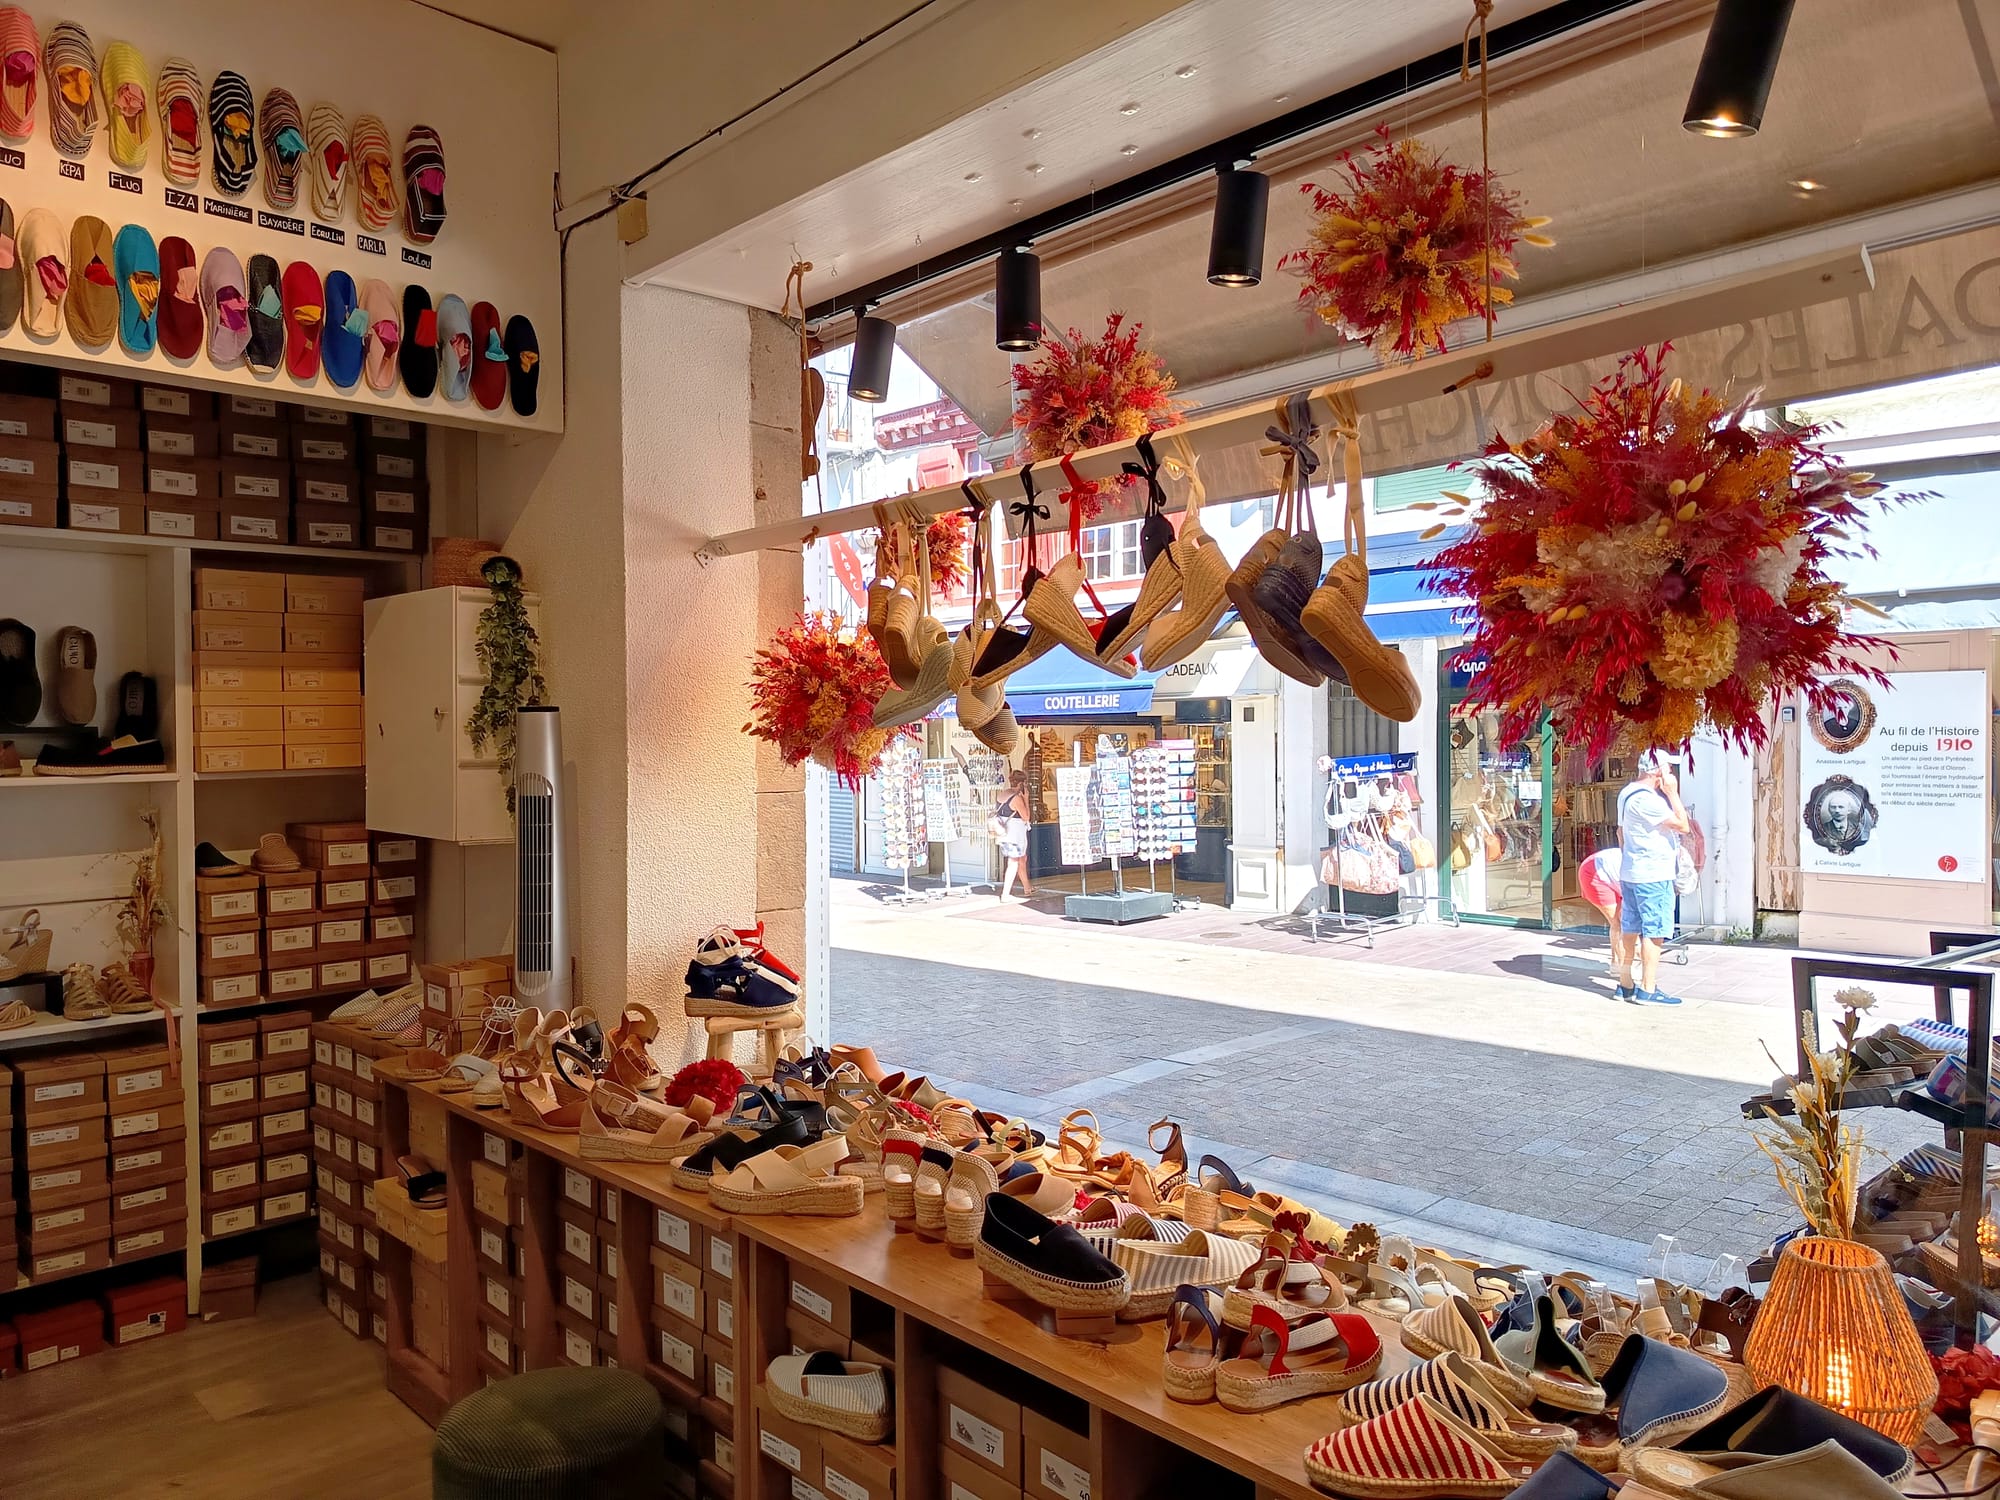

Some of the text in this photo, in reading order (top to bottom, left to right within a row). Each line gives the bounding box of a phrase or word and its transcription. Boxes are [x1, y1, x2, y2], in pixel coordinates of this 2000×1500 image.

[167, 191, 196, 209] IZA
[834, 541, 860, 591] TABAC
[1044, 694, 1121, 710] COUTELLERIE
[1880, 727, 1980, 736] Au fil de l'Histoire
[1890, 738, 1973, 754] depuis 1910
[985, 1442, 996, 1454] 37
